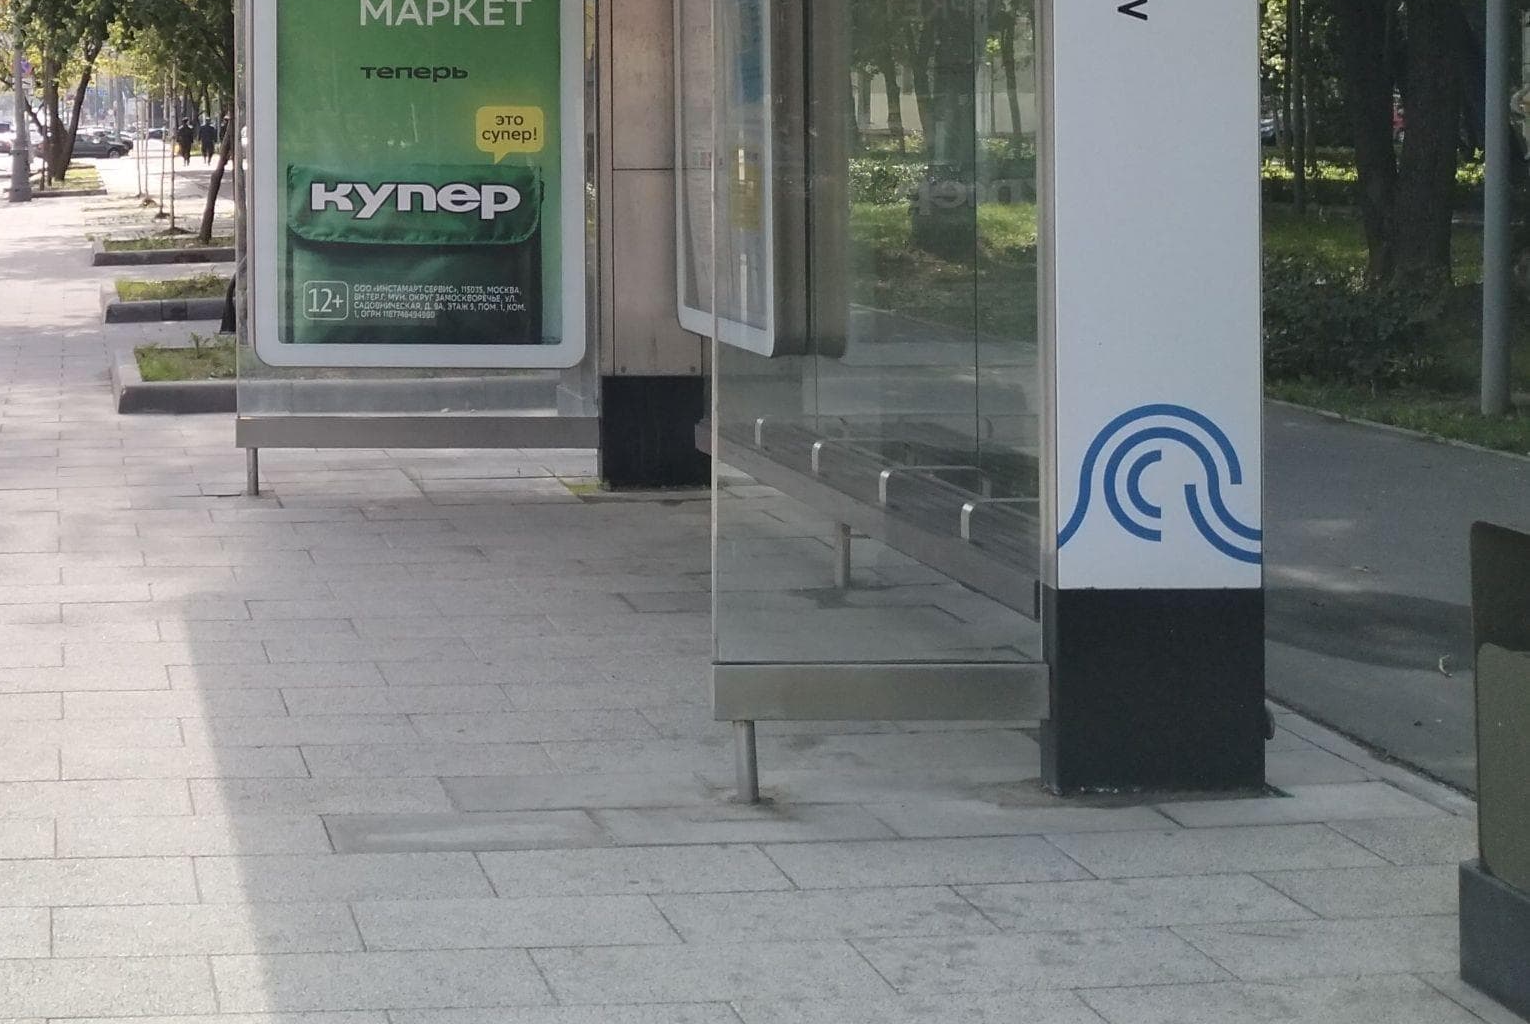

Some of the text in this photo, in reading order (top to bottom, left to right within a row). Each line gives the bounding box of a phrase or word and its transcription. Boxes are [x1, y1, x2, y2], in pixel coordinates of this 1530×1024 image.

[360, 66, 469, 83] теперь
[495, 115, 524, 126] это
[481, 127, 538, 144] супер!
[310, 182, 522, 220] купер
[308, 288, 344, 313] 12+
